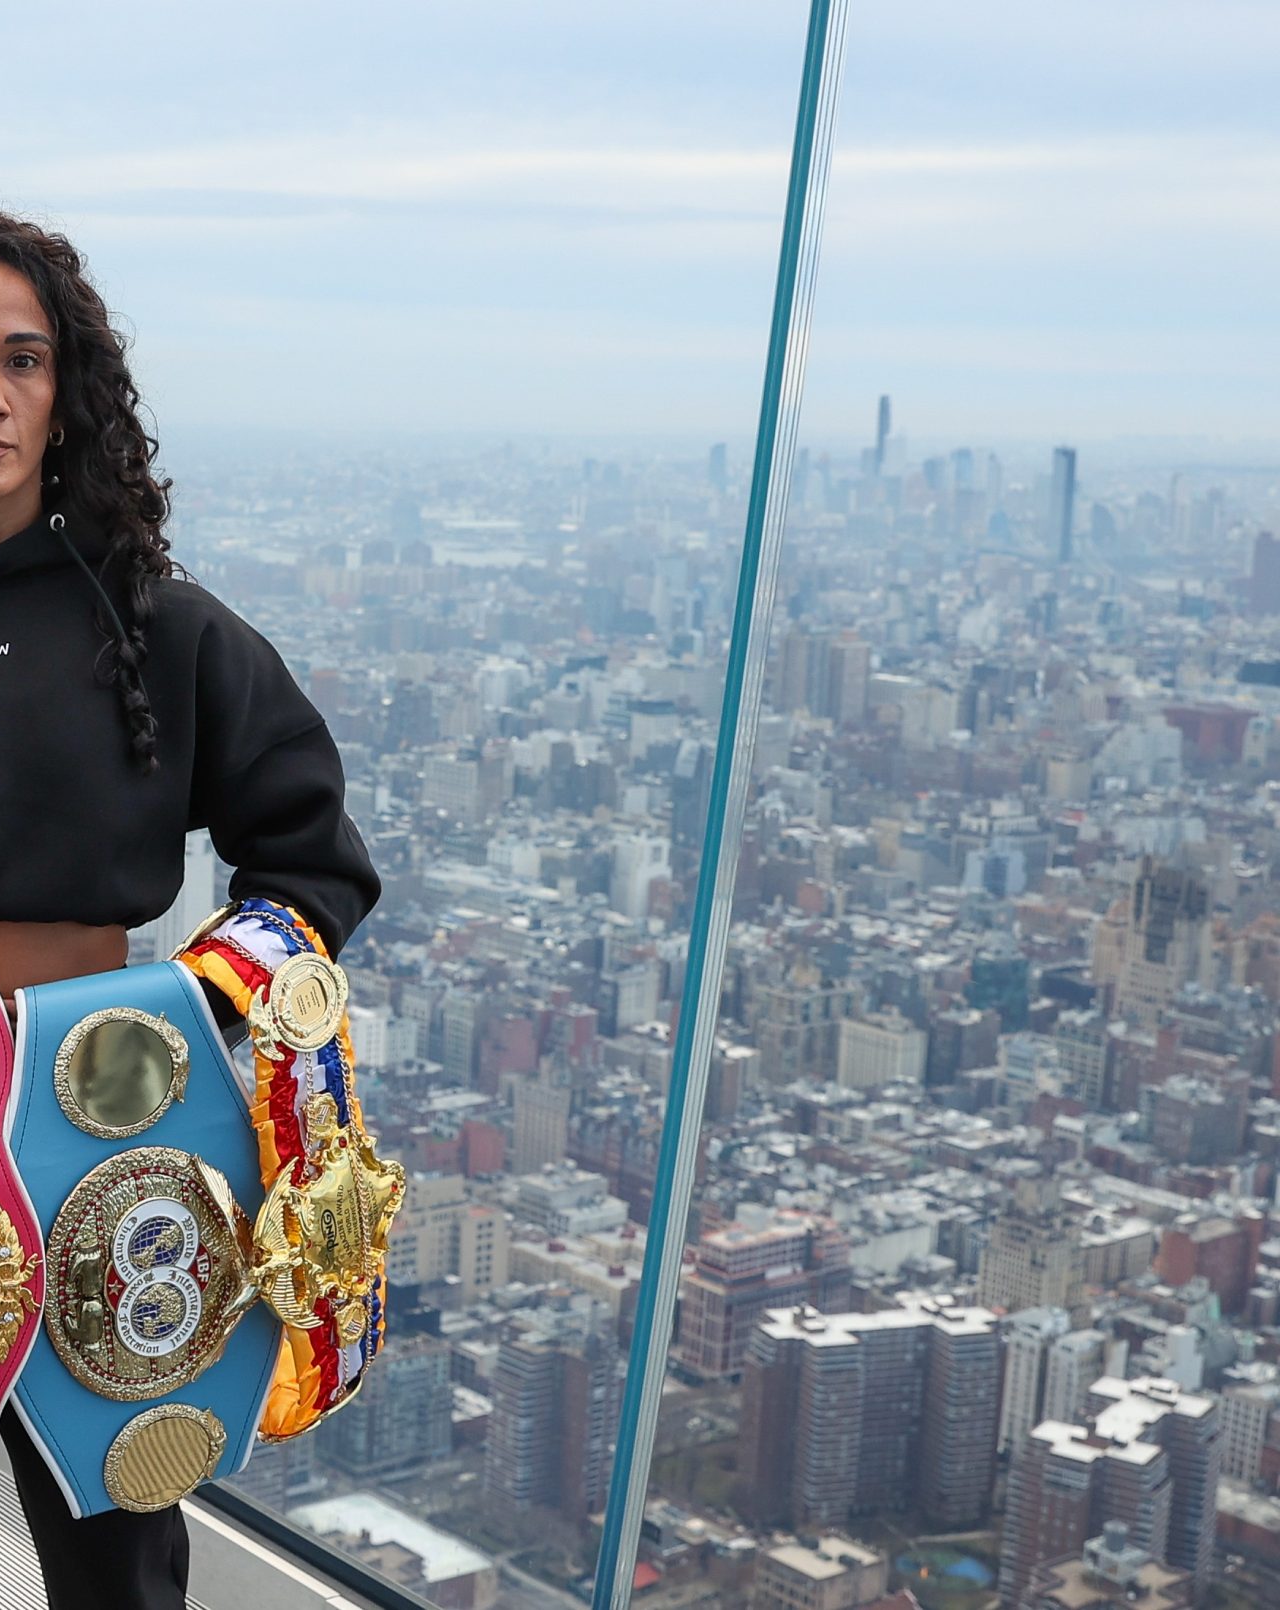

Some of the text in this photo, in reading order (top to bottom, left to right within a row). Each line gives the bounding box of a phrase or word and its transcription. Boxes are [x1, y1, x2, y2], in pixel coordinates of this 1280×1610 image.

[115, 1216, 138, 1279] Champion
[181, 1215, 196, 1259] World
[323, 1212, 339, 1252] RING
[196, 1252, 211, 1283] IBF
